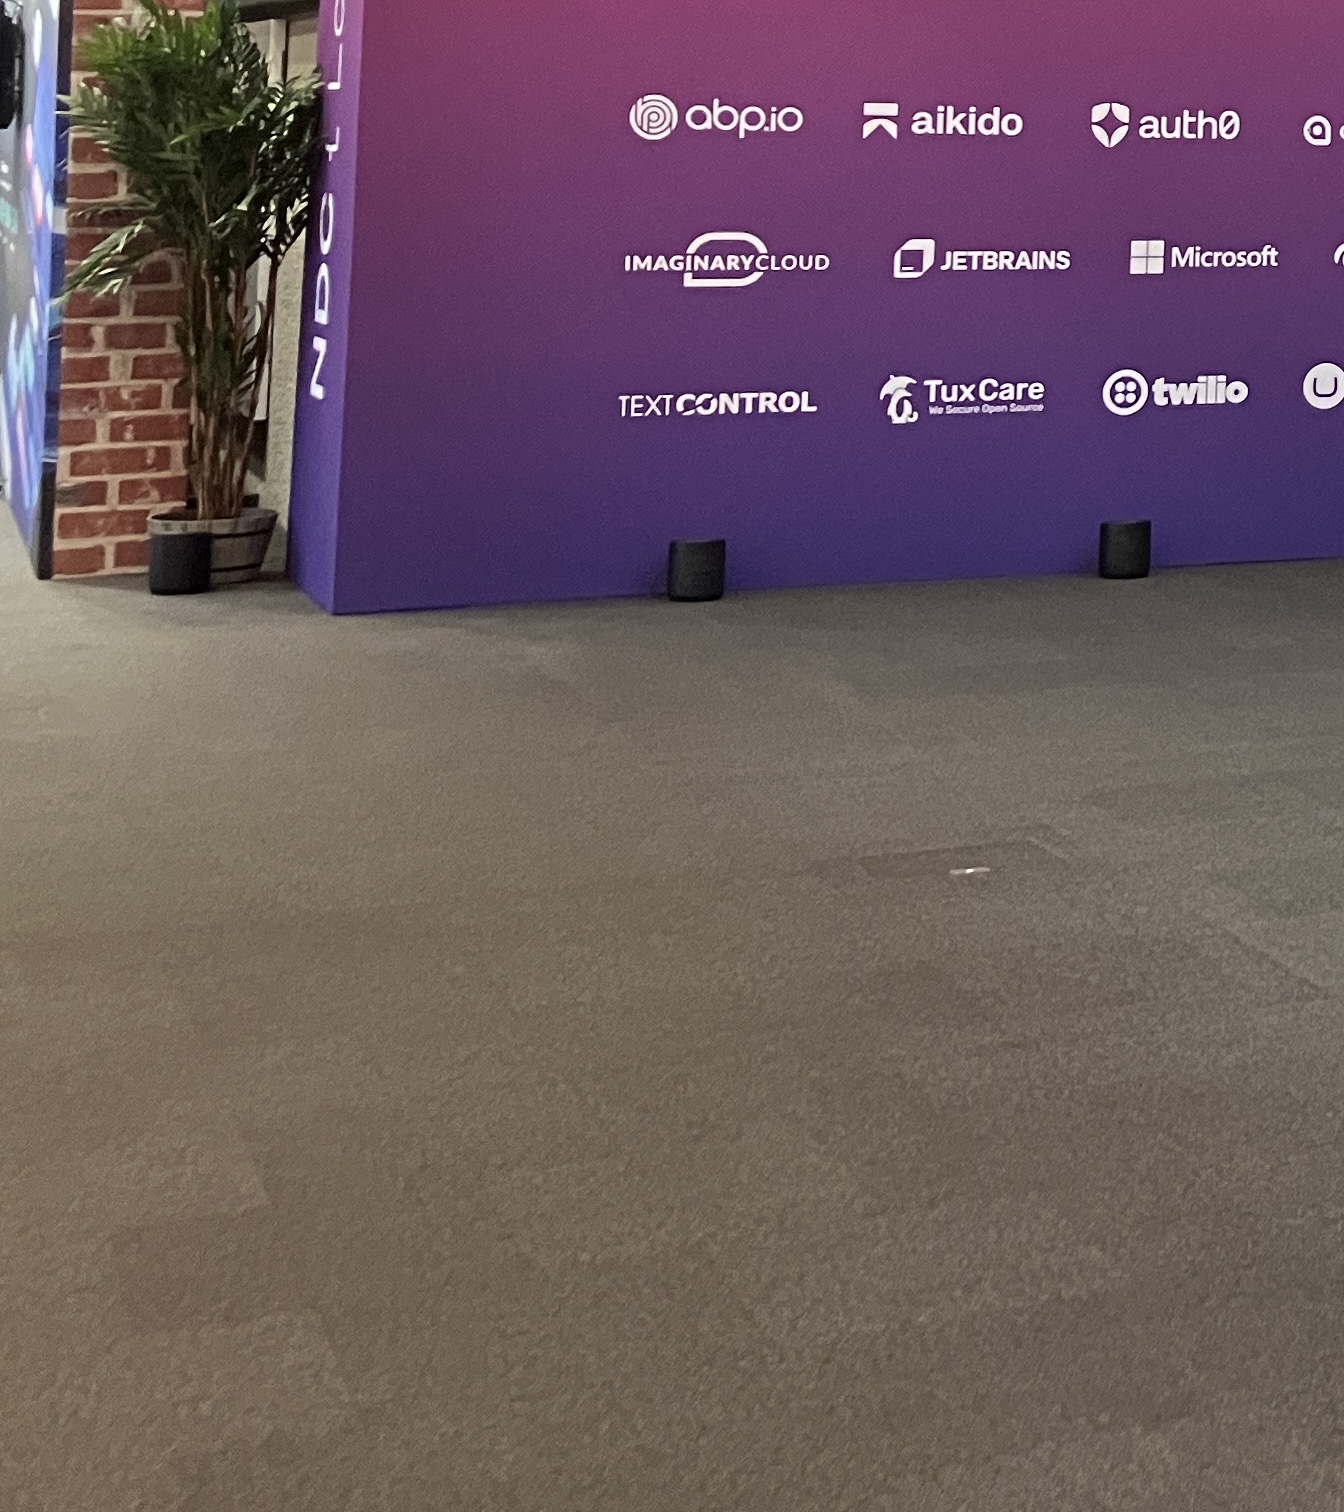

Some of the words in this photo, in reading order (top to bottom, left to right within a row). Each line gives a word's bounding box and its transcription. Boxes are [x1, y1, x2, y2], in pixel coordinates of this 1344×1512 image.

[686, 99, 803, 138] abp.io
[912, 106, 1022, 135] aikido
[941, 251, 1070, 270] JETBRAINS
[1172, 245, 1278, 267] Microsoft
[1152, 375, 1248, 406] twilio
[981, 403, 1008, 415] Open
